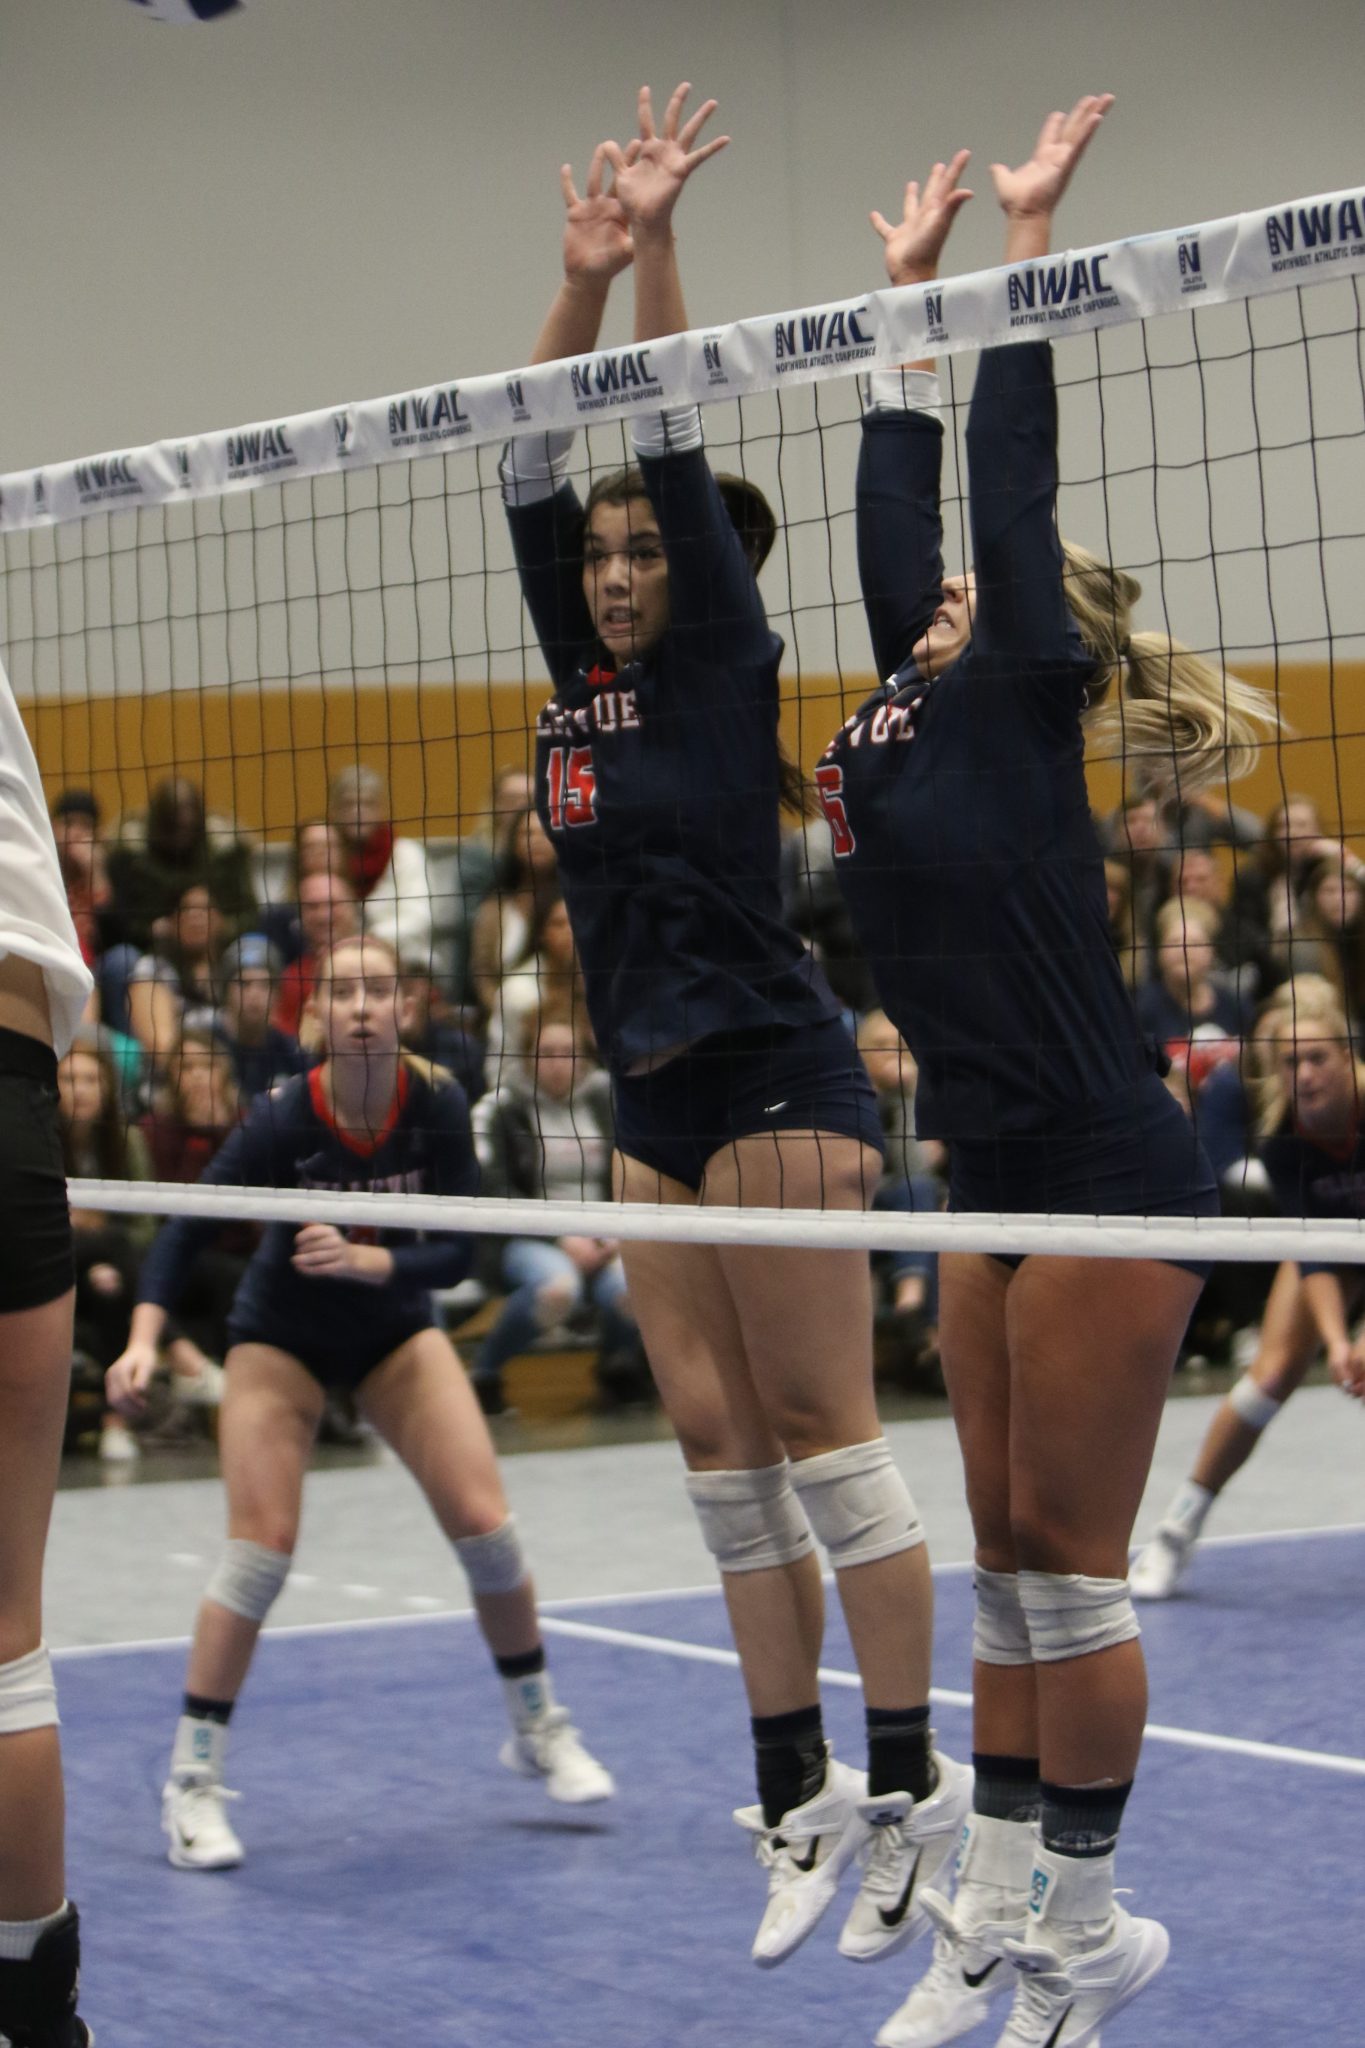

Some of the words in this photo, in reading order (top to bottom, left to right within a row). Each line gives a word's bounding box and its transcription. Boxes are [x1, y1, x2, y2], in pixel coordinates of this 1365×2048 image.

[1266, 196, 1365, 256] NWA
[1007, 253, 1113, 311] NWAC
[1178, 241, 1201, 274] N
[774, 306, 875, 358] NWAC
[570, 349, 659, 398] NWAC
[388, 387, 469, 434] NWAC
[545, 744, 599, 831] 15
